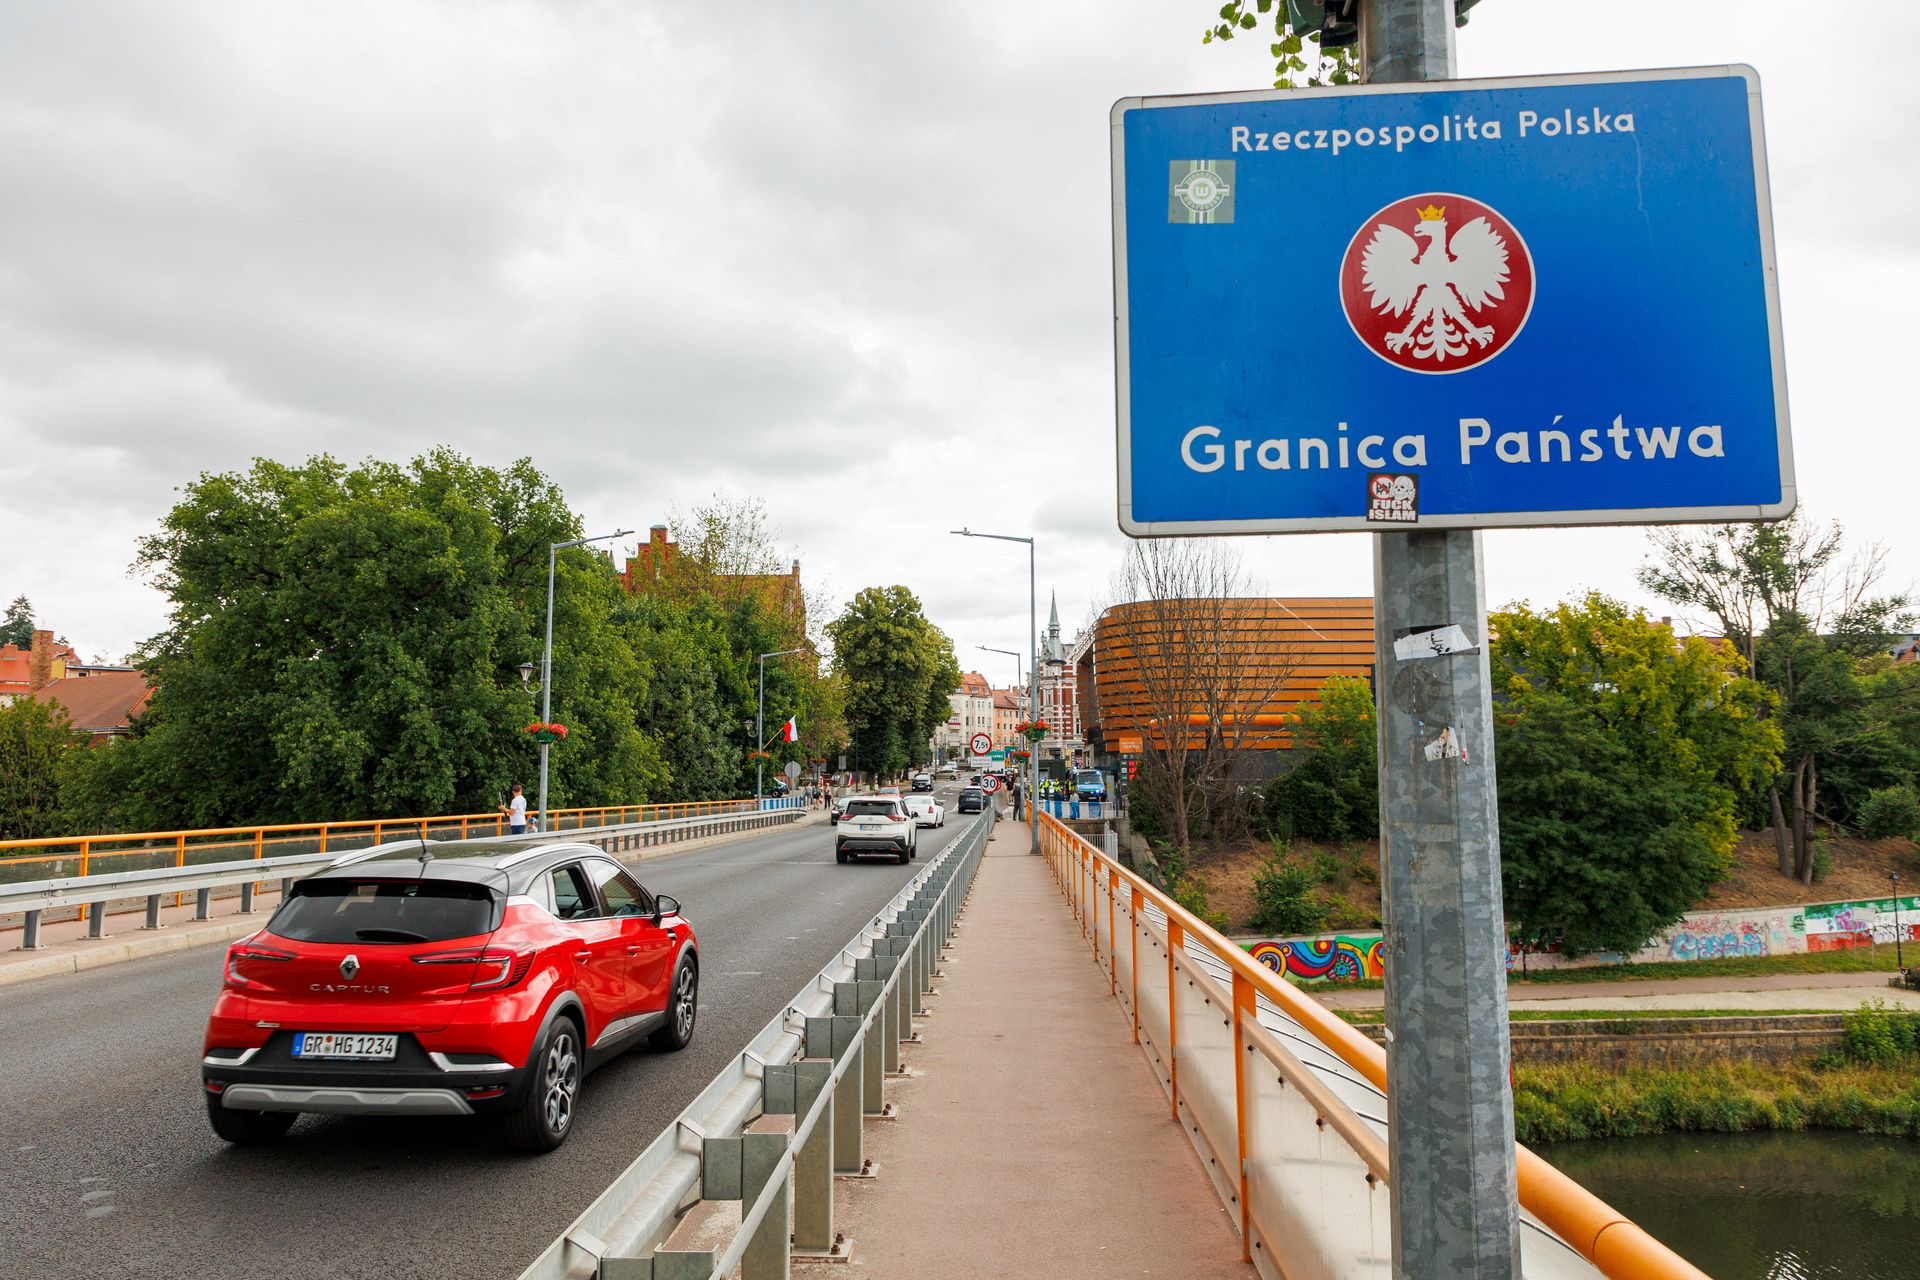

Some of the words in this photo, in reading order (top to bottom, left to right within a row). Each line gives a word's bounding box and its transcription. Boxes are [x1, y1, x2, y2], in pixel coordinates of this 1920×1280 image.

[1231, 114, 1502, 156] Rzeczpospolita
[1518, 107, 1636, 138] Polska
[1181, 422, 1427, 473] Granica
[1459, 414, 1725, 465] Państwa
[1373, 499, 1413, 511] FUCK
[1369, 509, 1416, 521] ISLAM
[983, 778, 996, 789] 30
[309, 983, 390, 994] CAPTUR
[304, 1036, 323, 1053] GR
[333, 1036, 354, 1053] HG
[355, 1037, 393, 1055] 1234
